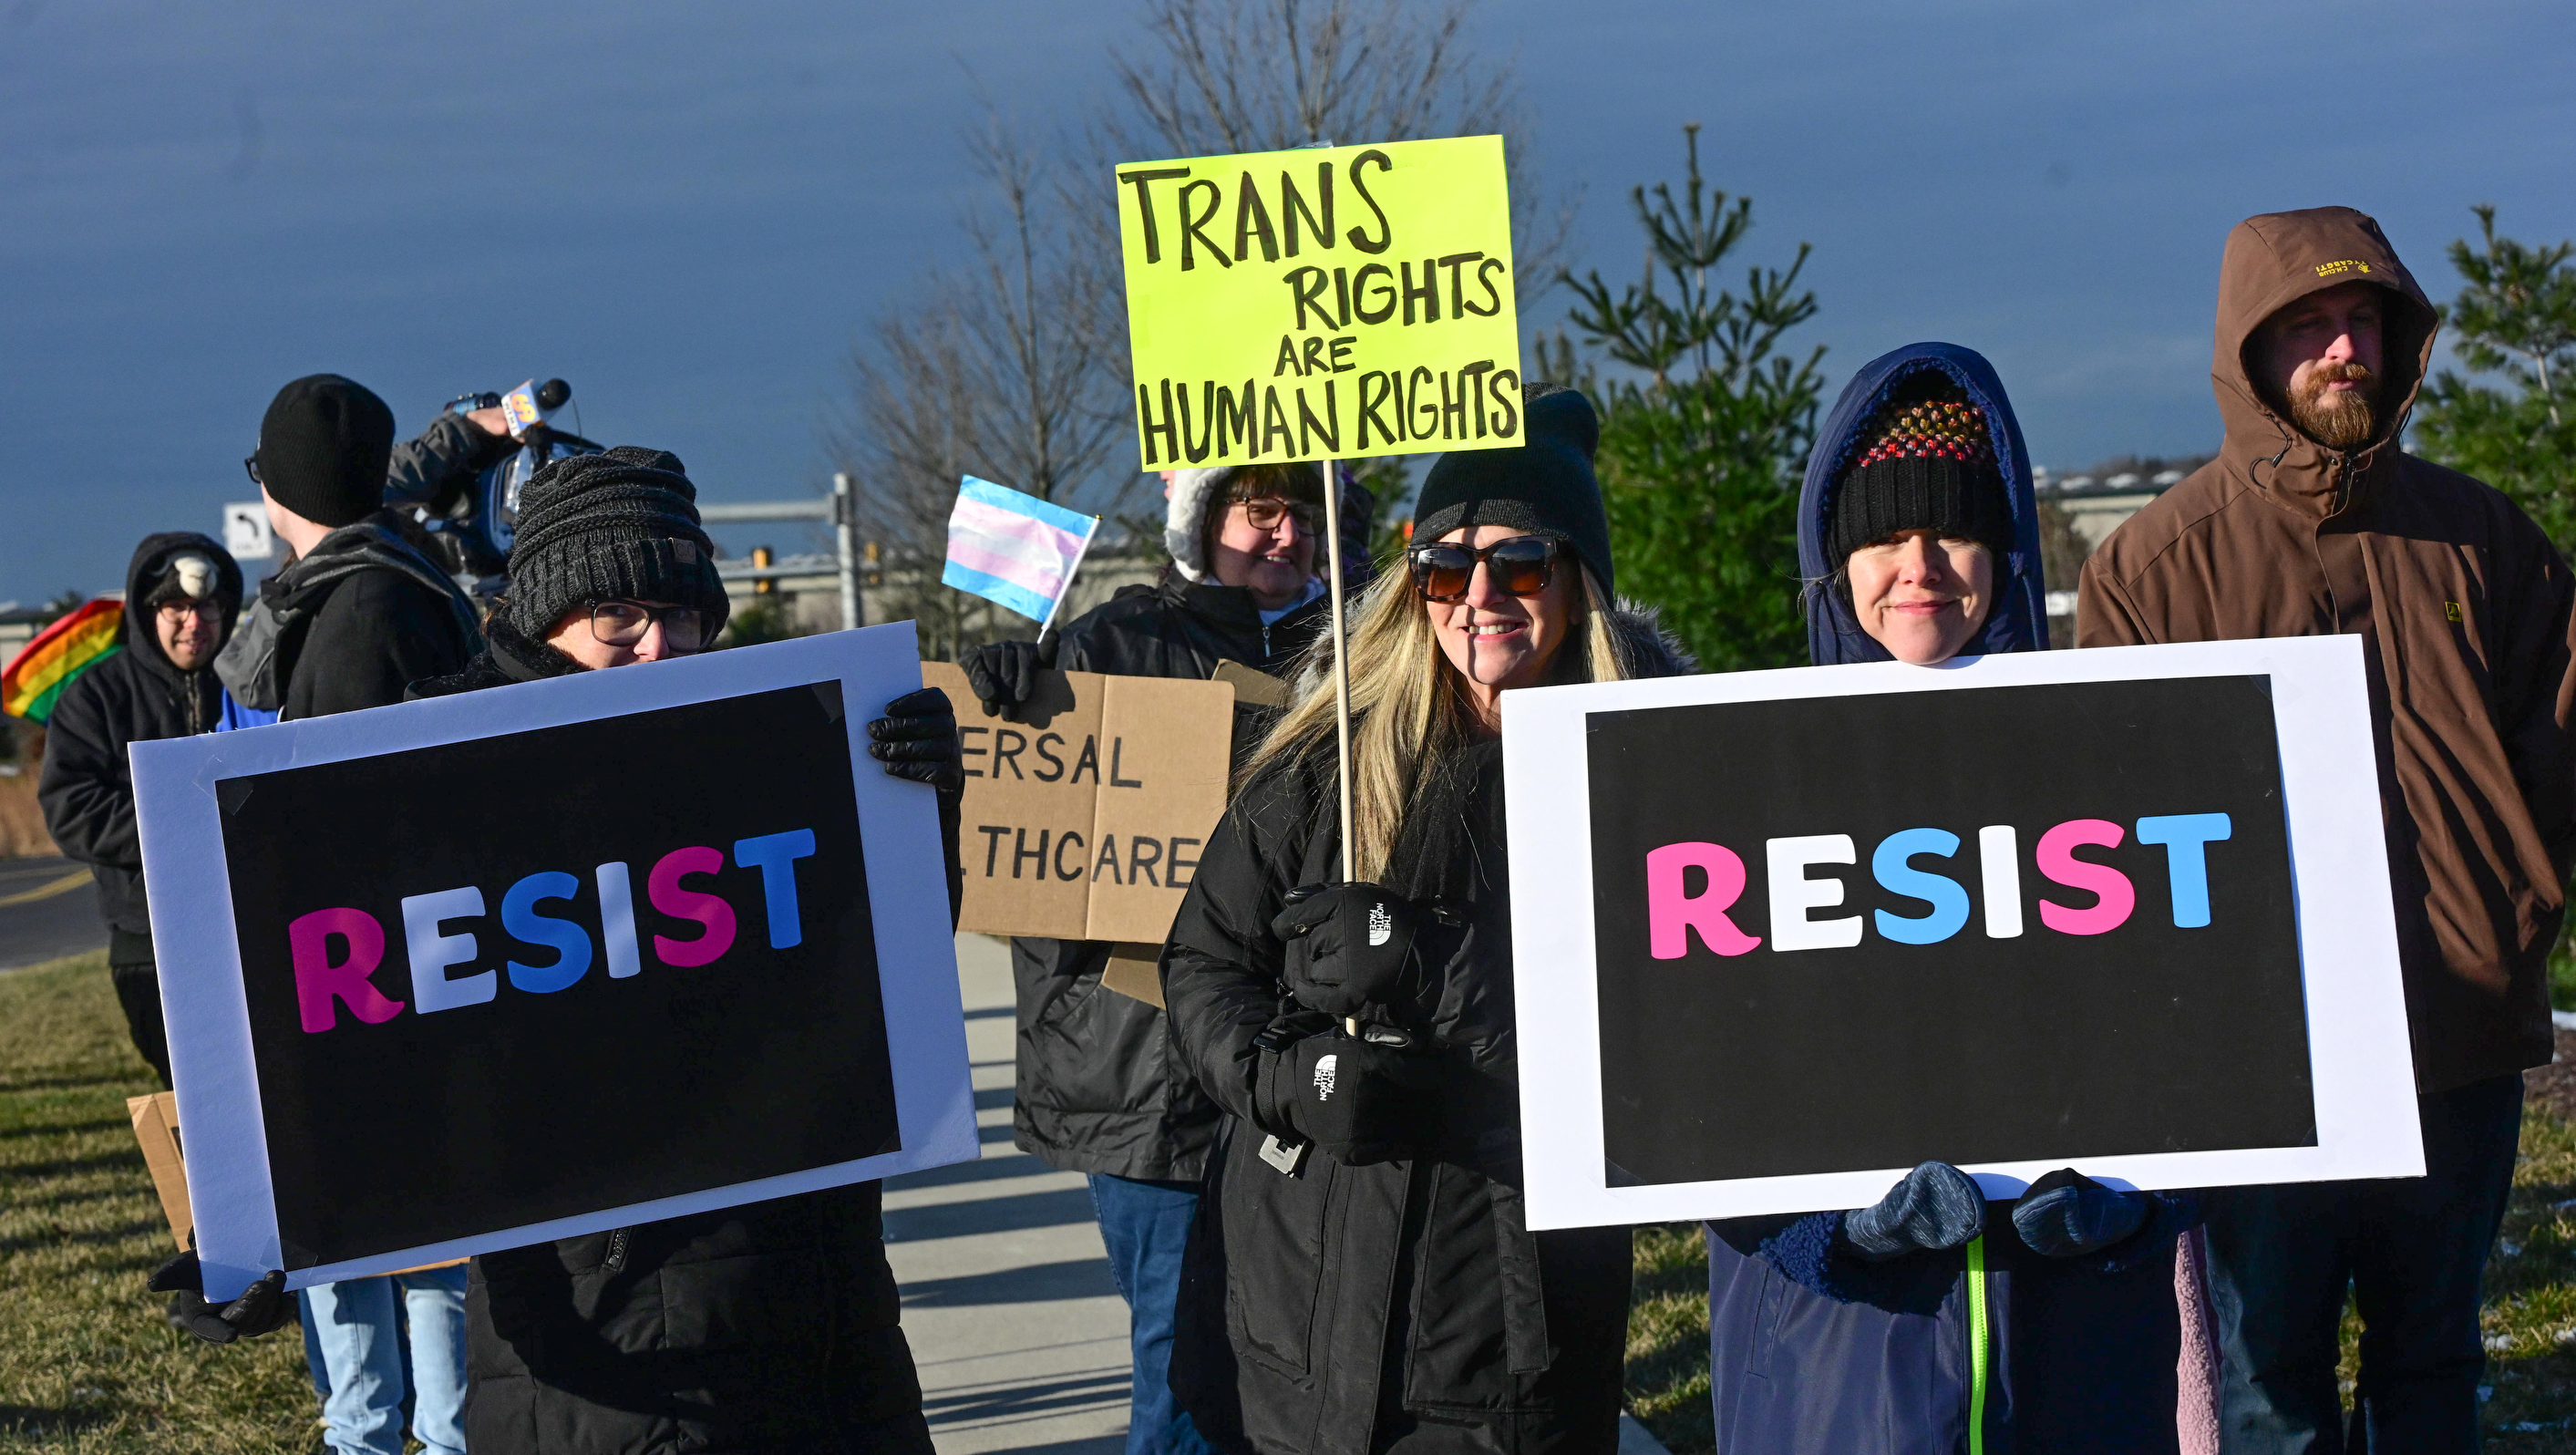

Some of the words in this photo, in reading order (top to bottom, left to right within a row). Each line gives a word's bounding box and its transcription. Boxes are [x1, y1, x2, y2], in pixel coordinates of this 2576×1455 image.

[1118, 149, 1393, 272] TRANS
[1283, 251, 1505, 331] RIGHTS
[1273, 334, 1357, 377] ARE
[510, 393, 536, 422] 69
[1139, 377, 1340, 465] HUMAN
[1356, 359, 1520, 450] RIGHTS
[962, 825, 1201, 890] THCARE
[1646, 812, 2231, 960] RESIST
[288, 828, 816, 1034] RESIST
[1369, 909, 1377, 931] FACE
[1383, 914, 1391, 931] THE
[1314, 1068, 1322, 1087] THE
[1319, 1069, 1328, 1101] NORTH
[1327, 1070, 1335, 1093] FACE
